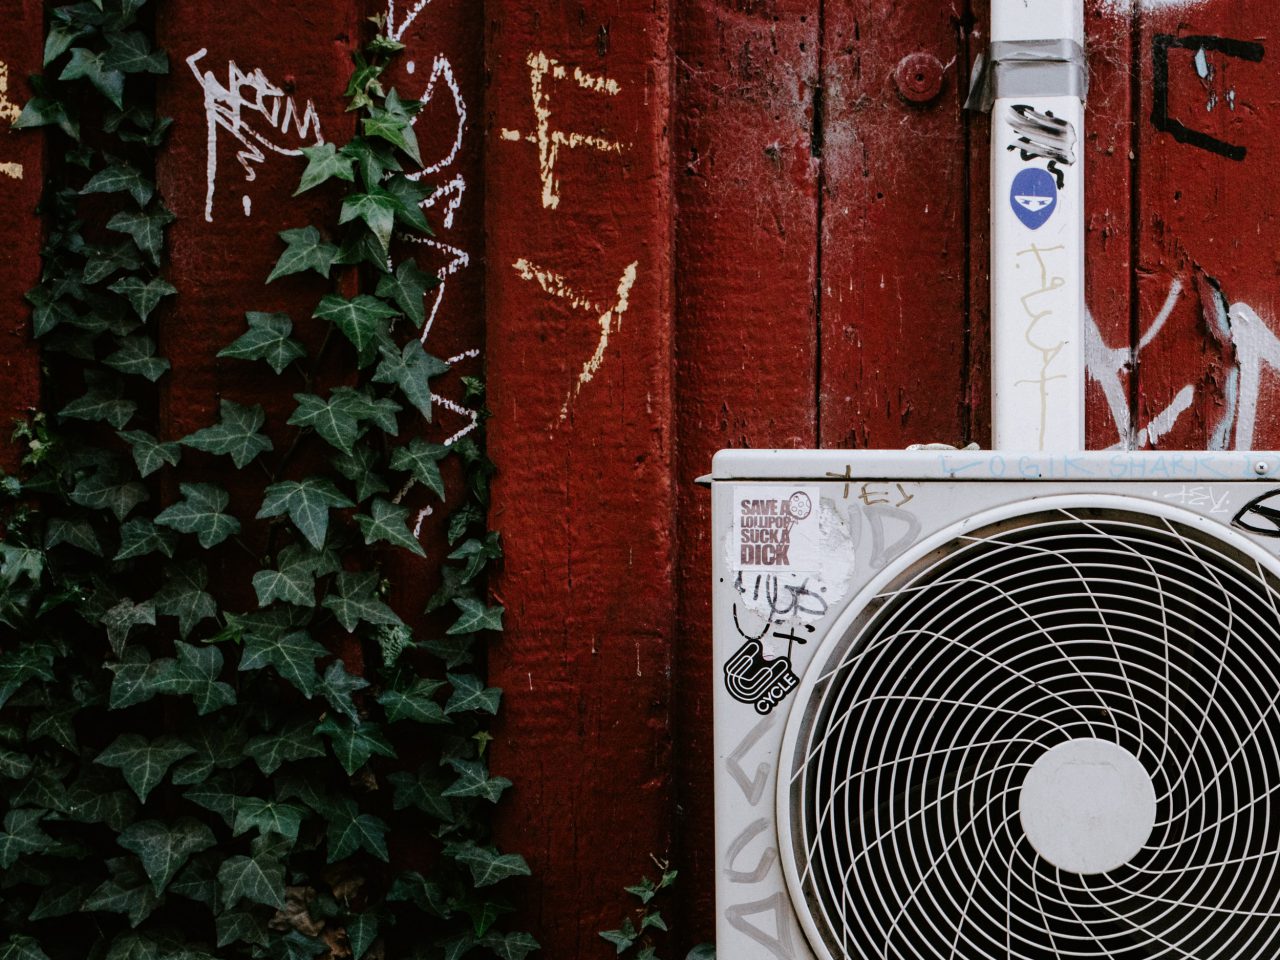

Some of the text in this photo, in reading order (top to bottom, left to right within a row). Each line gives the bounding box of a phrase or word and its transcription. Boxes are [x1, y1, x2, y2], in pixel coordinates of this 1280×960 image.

[741, 500, 791, 516] SAVE A
[741, 516, 791, 528] LOLLIPOP
[741, 529, 790, 543] SUCK A
[741, 544, 790, 565] DICK
[755, 673, 797, 713] CYCLE
